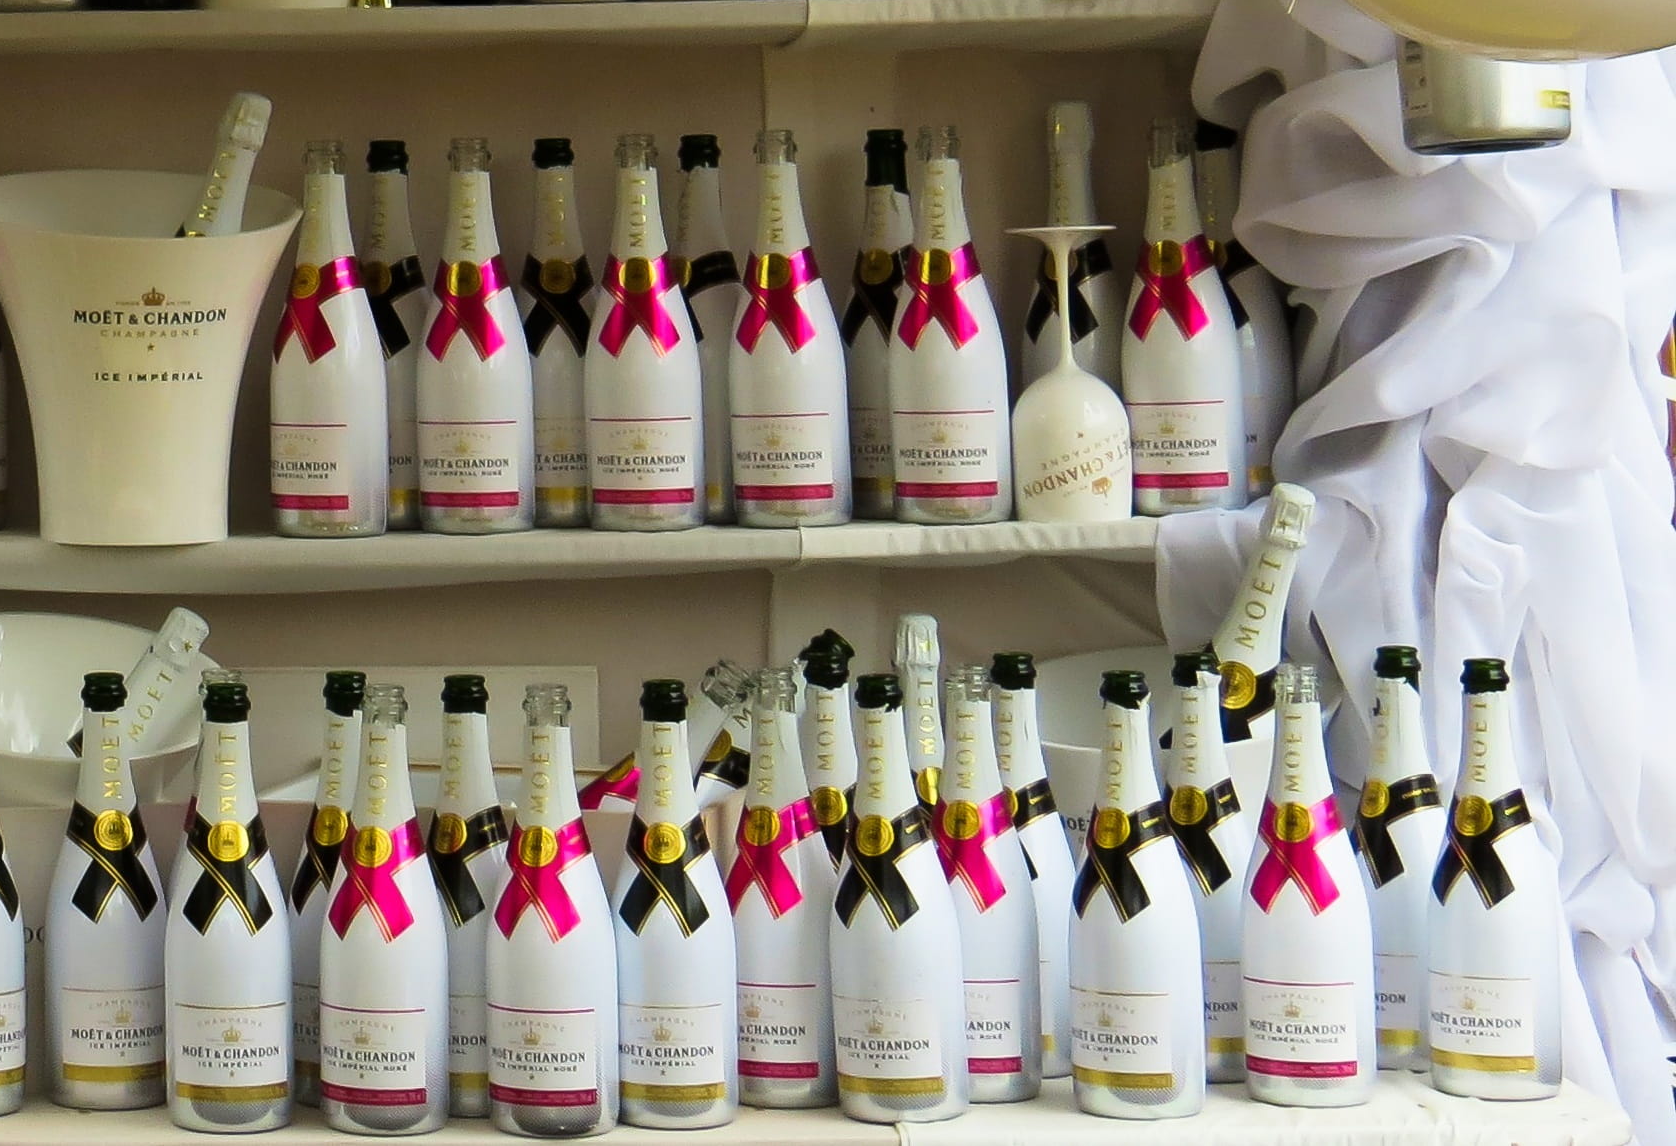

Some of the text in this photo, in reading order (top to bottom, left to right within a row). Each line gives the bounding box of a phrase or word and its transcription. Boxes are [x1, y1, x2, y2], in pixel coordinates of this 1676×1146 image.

[74, 309, 226, 325] MOËT & CHANDON
[100, 329, 199, 337] CHAMPAGNE
[96, 372, 202, 381] ICE IMPÉRIAL
[1161, 439, 1216, 449] CHANDON
[767, 451, 822, 461] CHANDON
[933, 449, 987, 458] CHANDON
[455, 459, 508, 468] CHANDON
[633, 456, 685, 465] CHANDON
[286, 462, 336, 471] CHANDON
[1460, 1017, 1521, 1028] CHANDON
[747, 1024, 805, 1036] CHANDON
[1285, 1024, 1345, 1035] CHANDON
[106, 1032, 112, 1040] &
[1098, 1034, 1158, 1045] CHANDON
[869, 1040, 929, 1051] CHANDON
[215, 1051, 220, 1059] &
[224, 1046, 279, 1059] CHANDON
[347, 1052, 353, 1060] &
[355, 1051, 415, 1062] CHANDON
[516, 1053, 522, 1061] &
[525, 1052, 585, 1063] CHANDON
[646, 1049, 652, 1058] &
[655, 1046, 713, 1058] CHANDON
